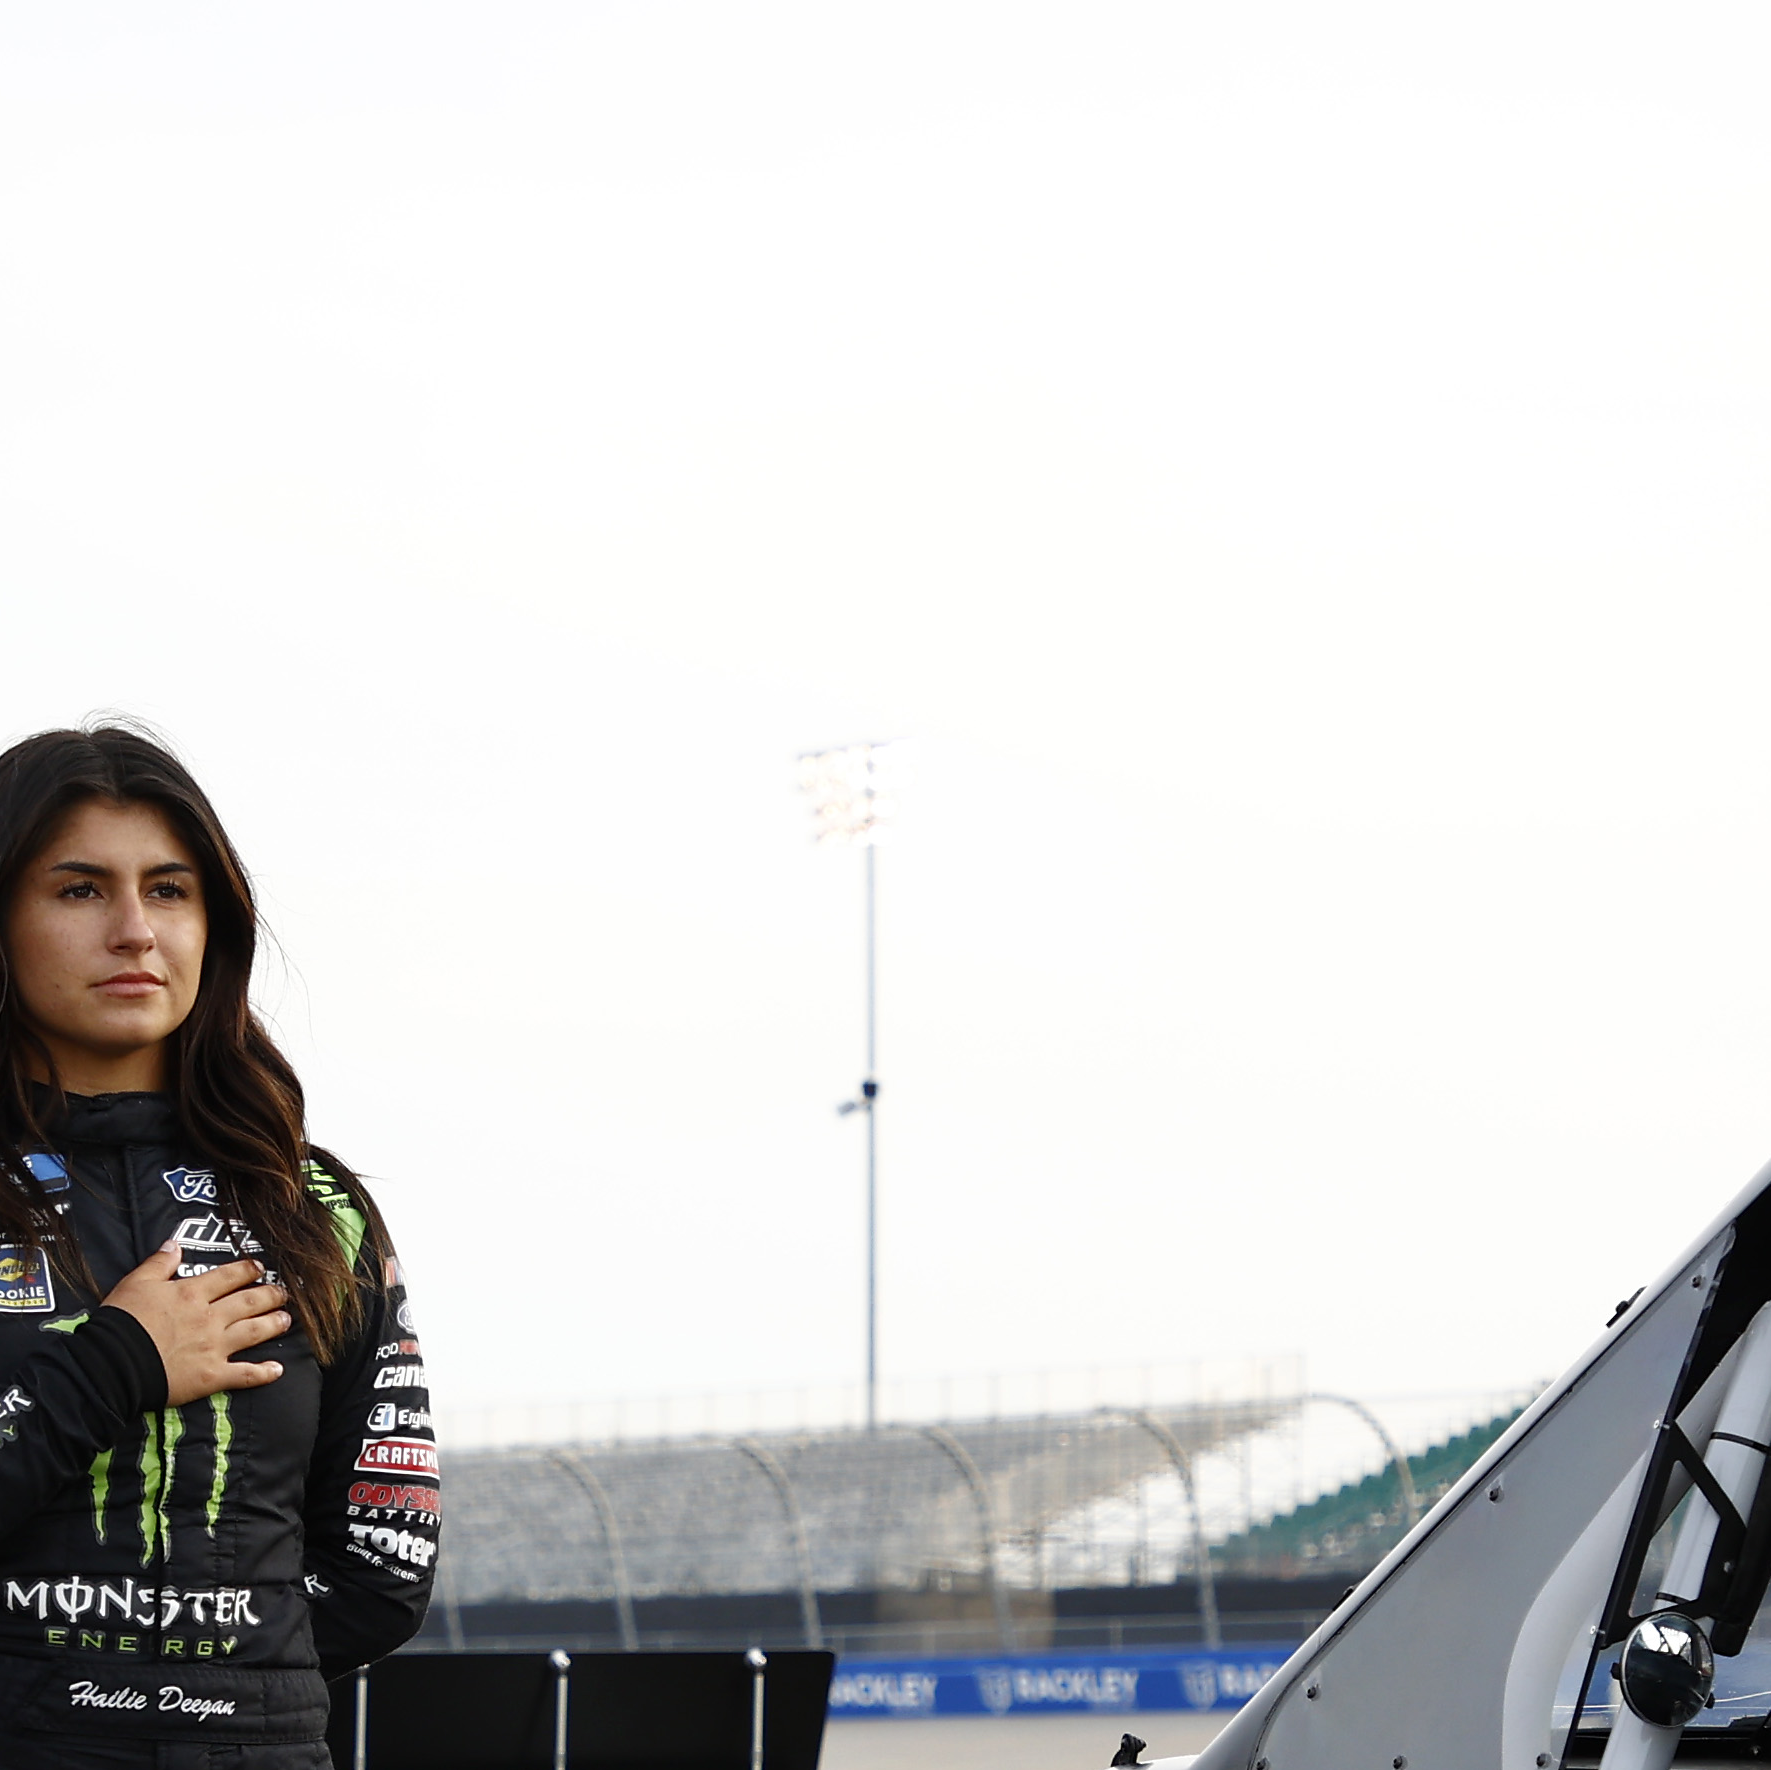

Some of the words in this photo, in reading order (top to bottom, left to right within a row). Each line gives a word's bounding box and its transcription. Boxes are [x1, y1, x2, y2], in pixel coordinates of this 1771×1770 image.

[179, 1174, 218, 1199] Fo
[348, 1523, 436, 1568] Toter
[6, 1575, 260, 1628] MONSTER
[47, 1629, 237, 1656] ENERGY
[69, 1681, 148, 1711] Hailie
[158, 1686, 236, 1722] Deegan
